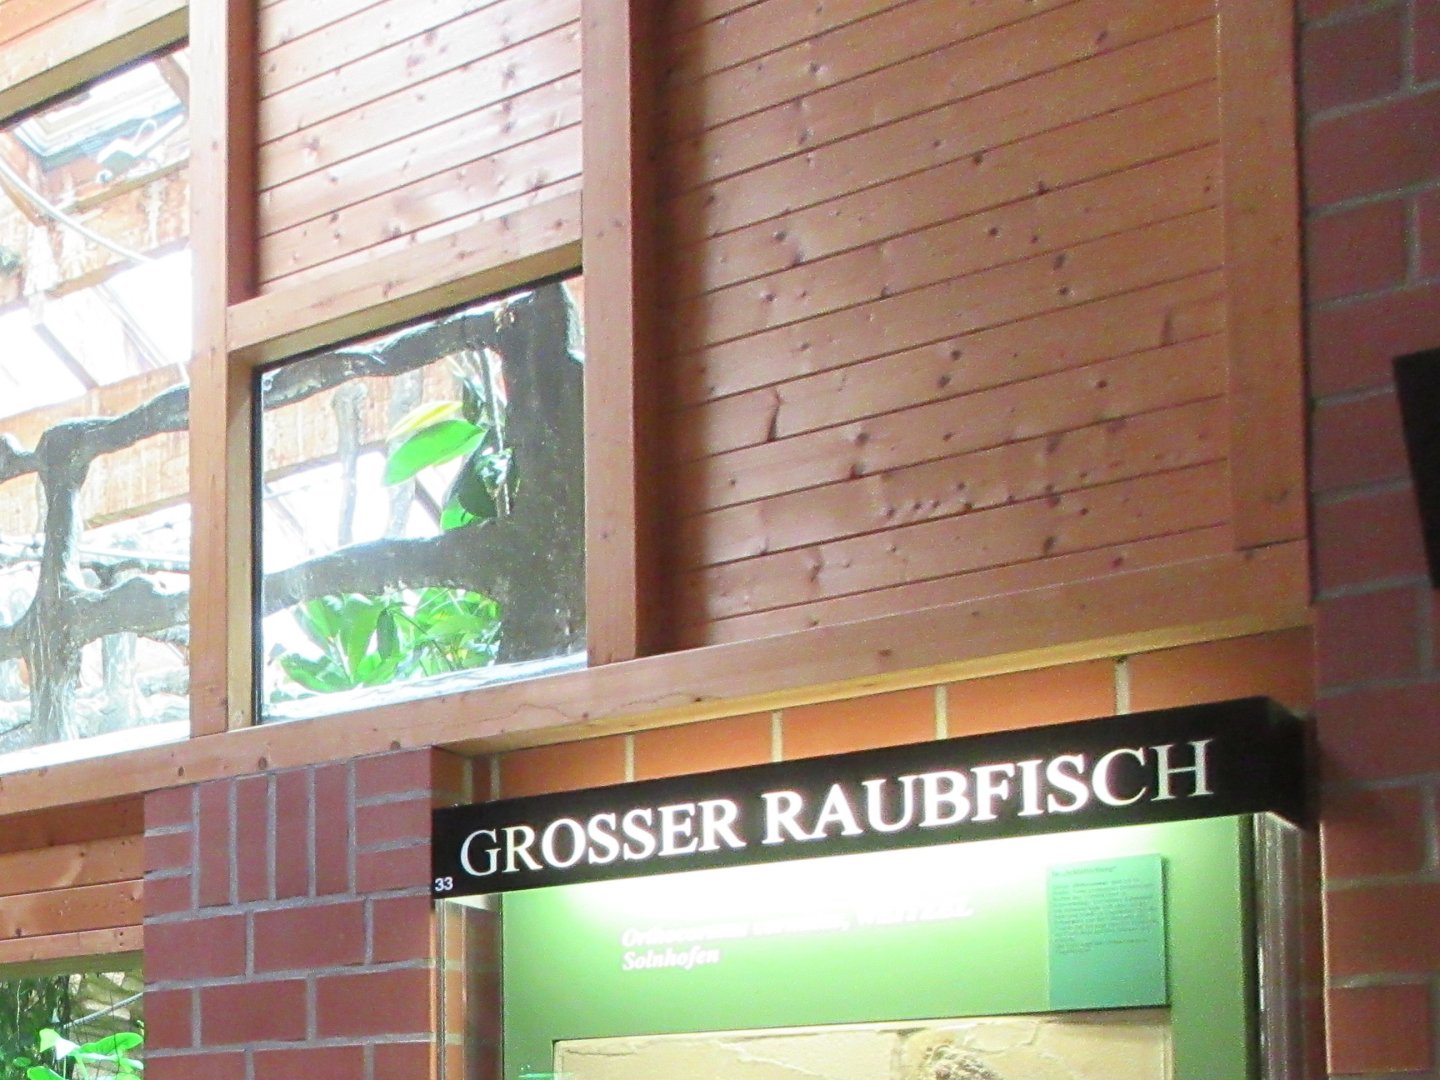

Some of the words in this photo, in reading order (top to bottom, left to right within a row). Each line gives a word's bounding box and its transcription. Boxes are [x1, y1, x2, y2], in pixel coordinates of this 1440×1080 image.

[461, 798, 746, 877] GROSSER
[761, 739, 1214, 845] RAUBFISCH
[434, 876, 454, 892] 33
[621, 945, 721, 971] Solnhofen
